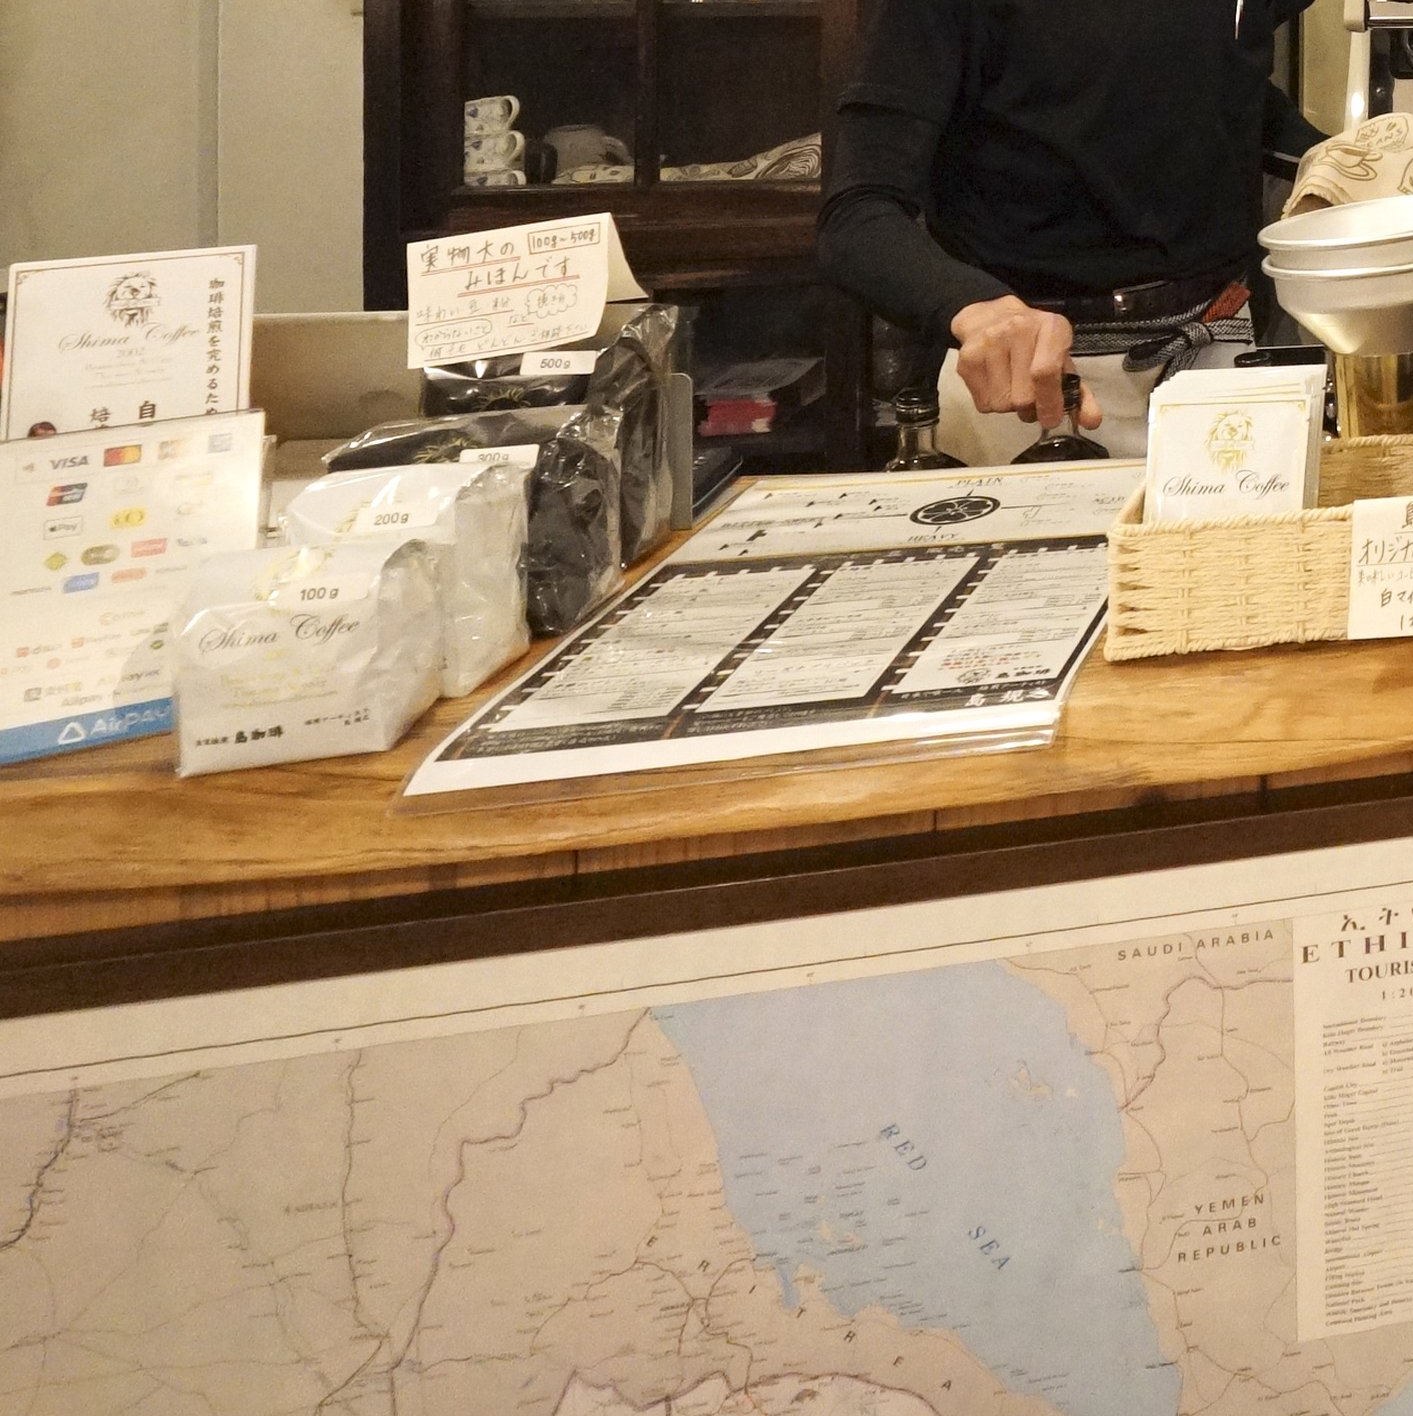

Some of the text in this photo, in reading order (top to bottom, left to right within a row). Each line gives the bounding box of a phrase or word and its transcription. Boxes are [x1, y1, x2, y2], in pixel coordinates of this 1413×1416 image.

[466, 256, 571, 291] みほんです
[58, 322, 201, 353] Shima Coffee
[50, 455, 89, 470] VISA
[1162, 469, 1291, 496] Shima Coffee
[200, 613, 360, 654] Shima Coffee
[1117, 929, 1274, 961] SAUDI ARABIA
[879, 1122, 1011, 1272] RED SEA
[1195, 1193, 1265, 1214] YEMEN
[1203, 1218, 1257, 1237] ARAB
[1178, 1235, 1281, 1263] REPUBLIC
